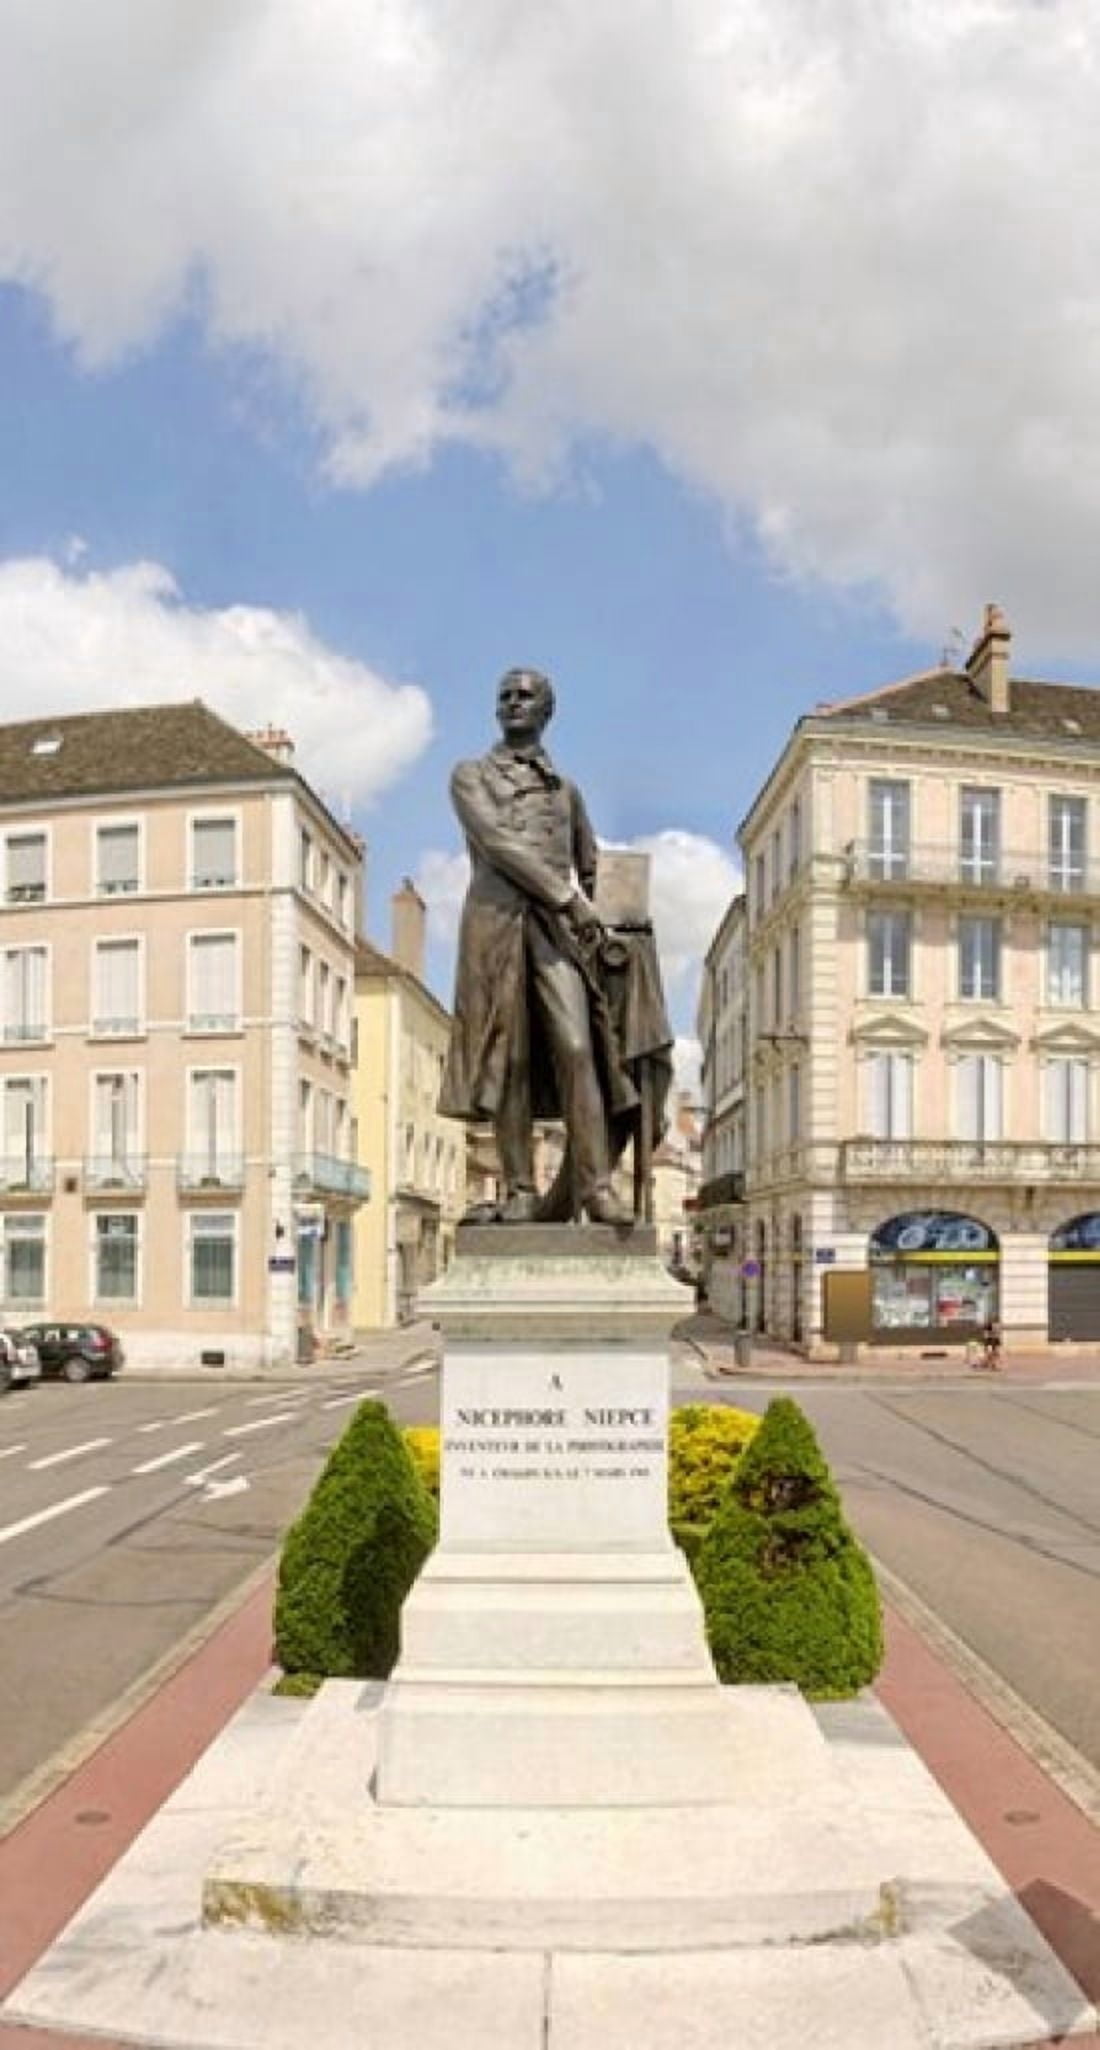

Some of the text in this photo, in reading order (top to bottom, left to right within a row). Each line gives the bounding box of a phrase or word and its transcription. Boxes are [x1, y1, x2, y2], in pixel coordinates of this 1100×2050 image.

[548, 1374, 564, 1391] A
[456, 1408, 653, 1426] NICEPHORE NIEPCE
[525, 1440, 539, 1453] DE
[545, 1440, 563, 1453] LA
